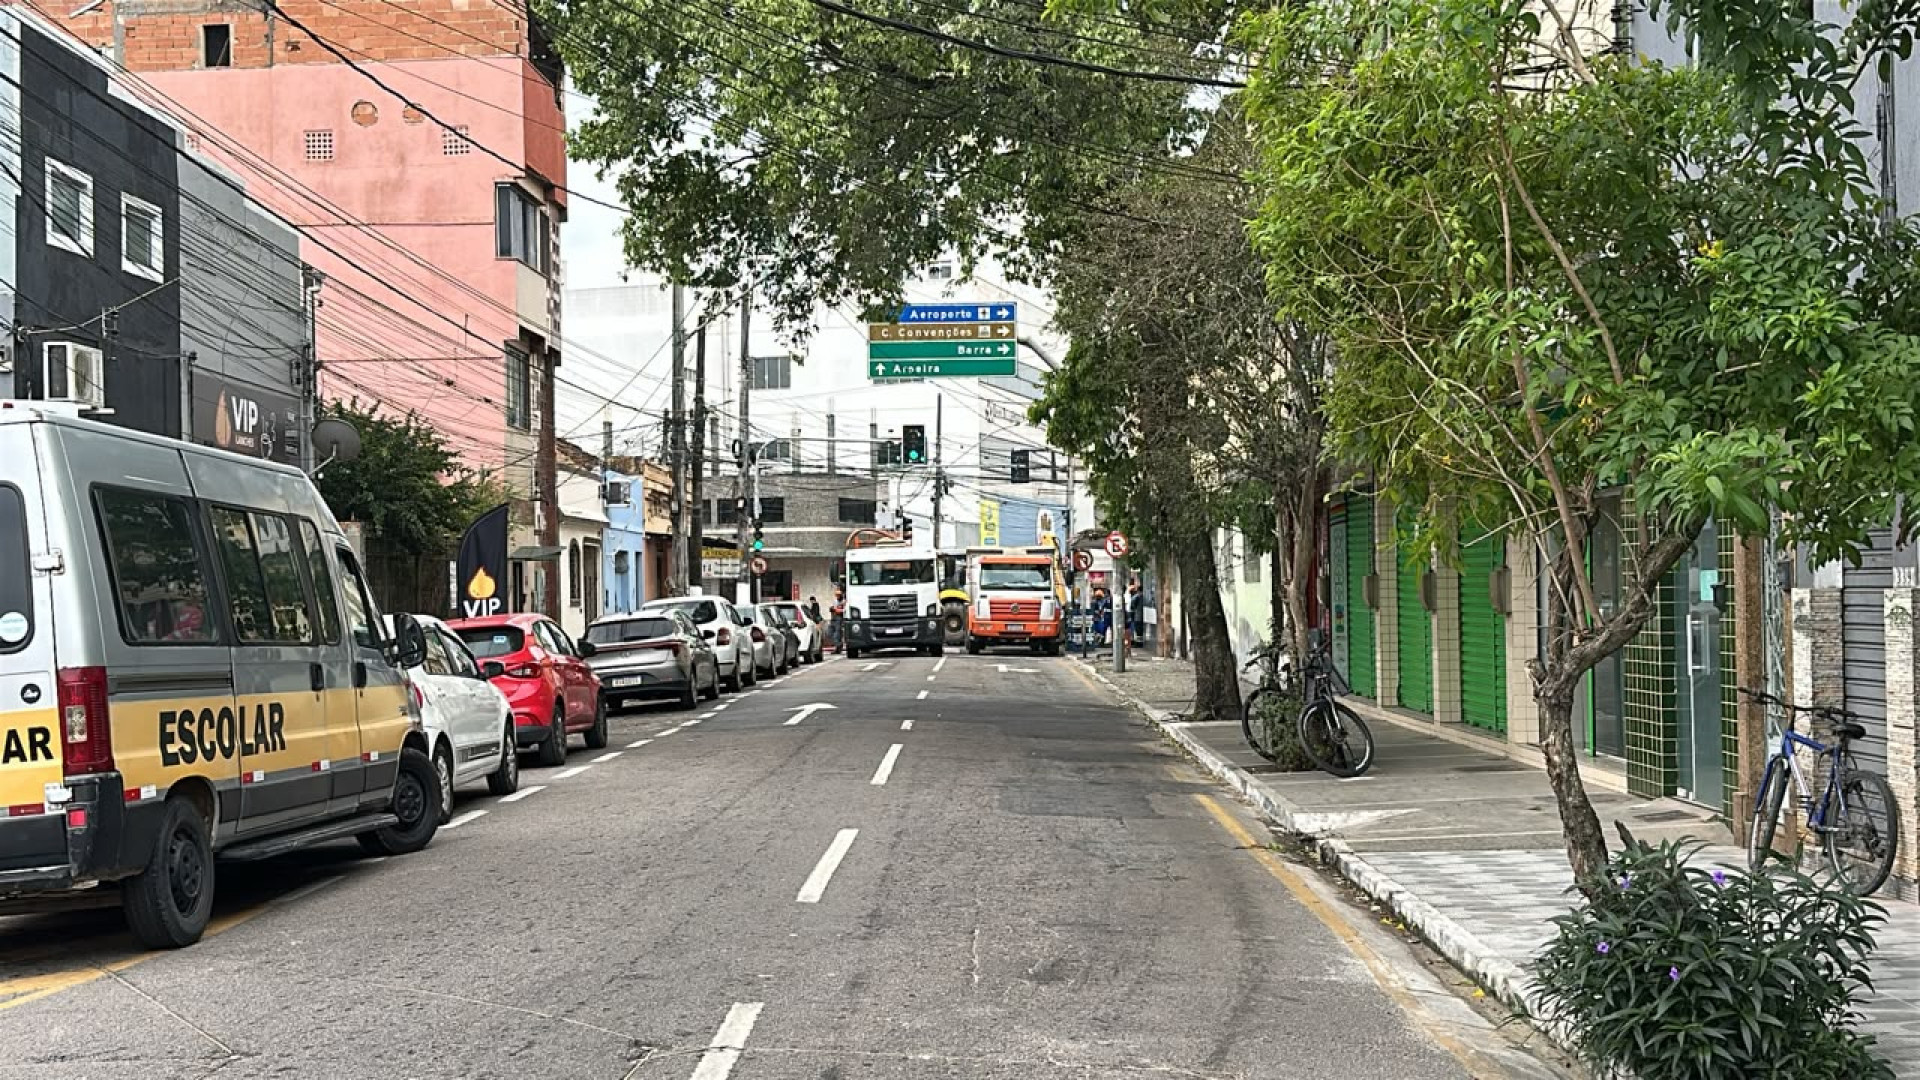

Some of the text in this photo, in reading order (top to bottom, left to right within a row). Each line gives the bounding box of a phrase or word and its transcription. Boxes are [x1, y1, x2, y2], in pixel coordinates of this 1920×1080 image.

[909, 309, 972, 320] Aeroporto
[881, 327, 972, 338] C. Convenções
[957, 345, 992, 355] Barra
[231, 395, 258, 433] VIP
[463, 597, 501, 618] VIP
[159, 702, 286, 767] ESCOLAR
